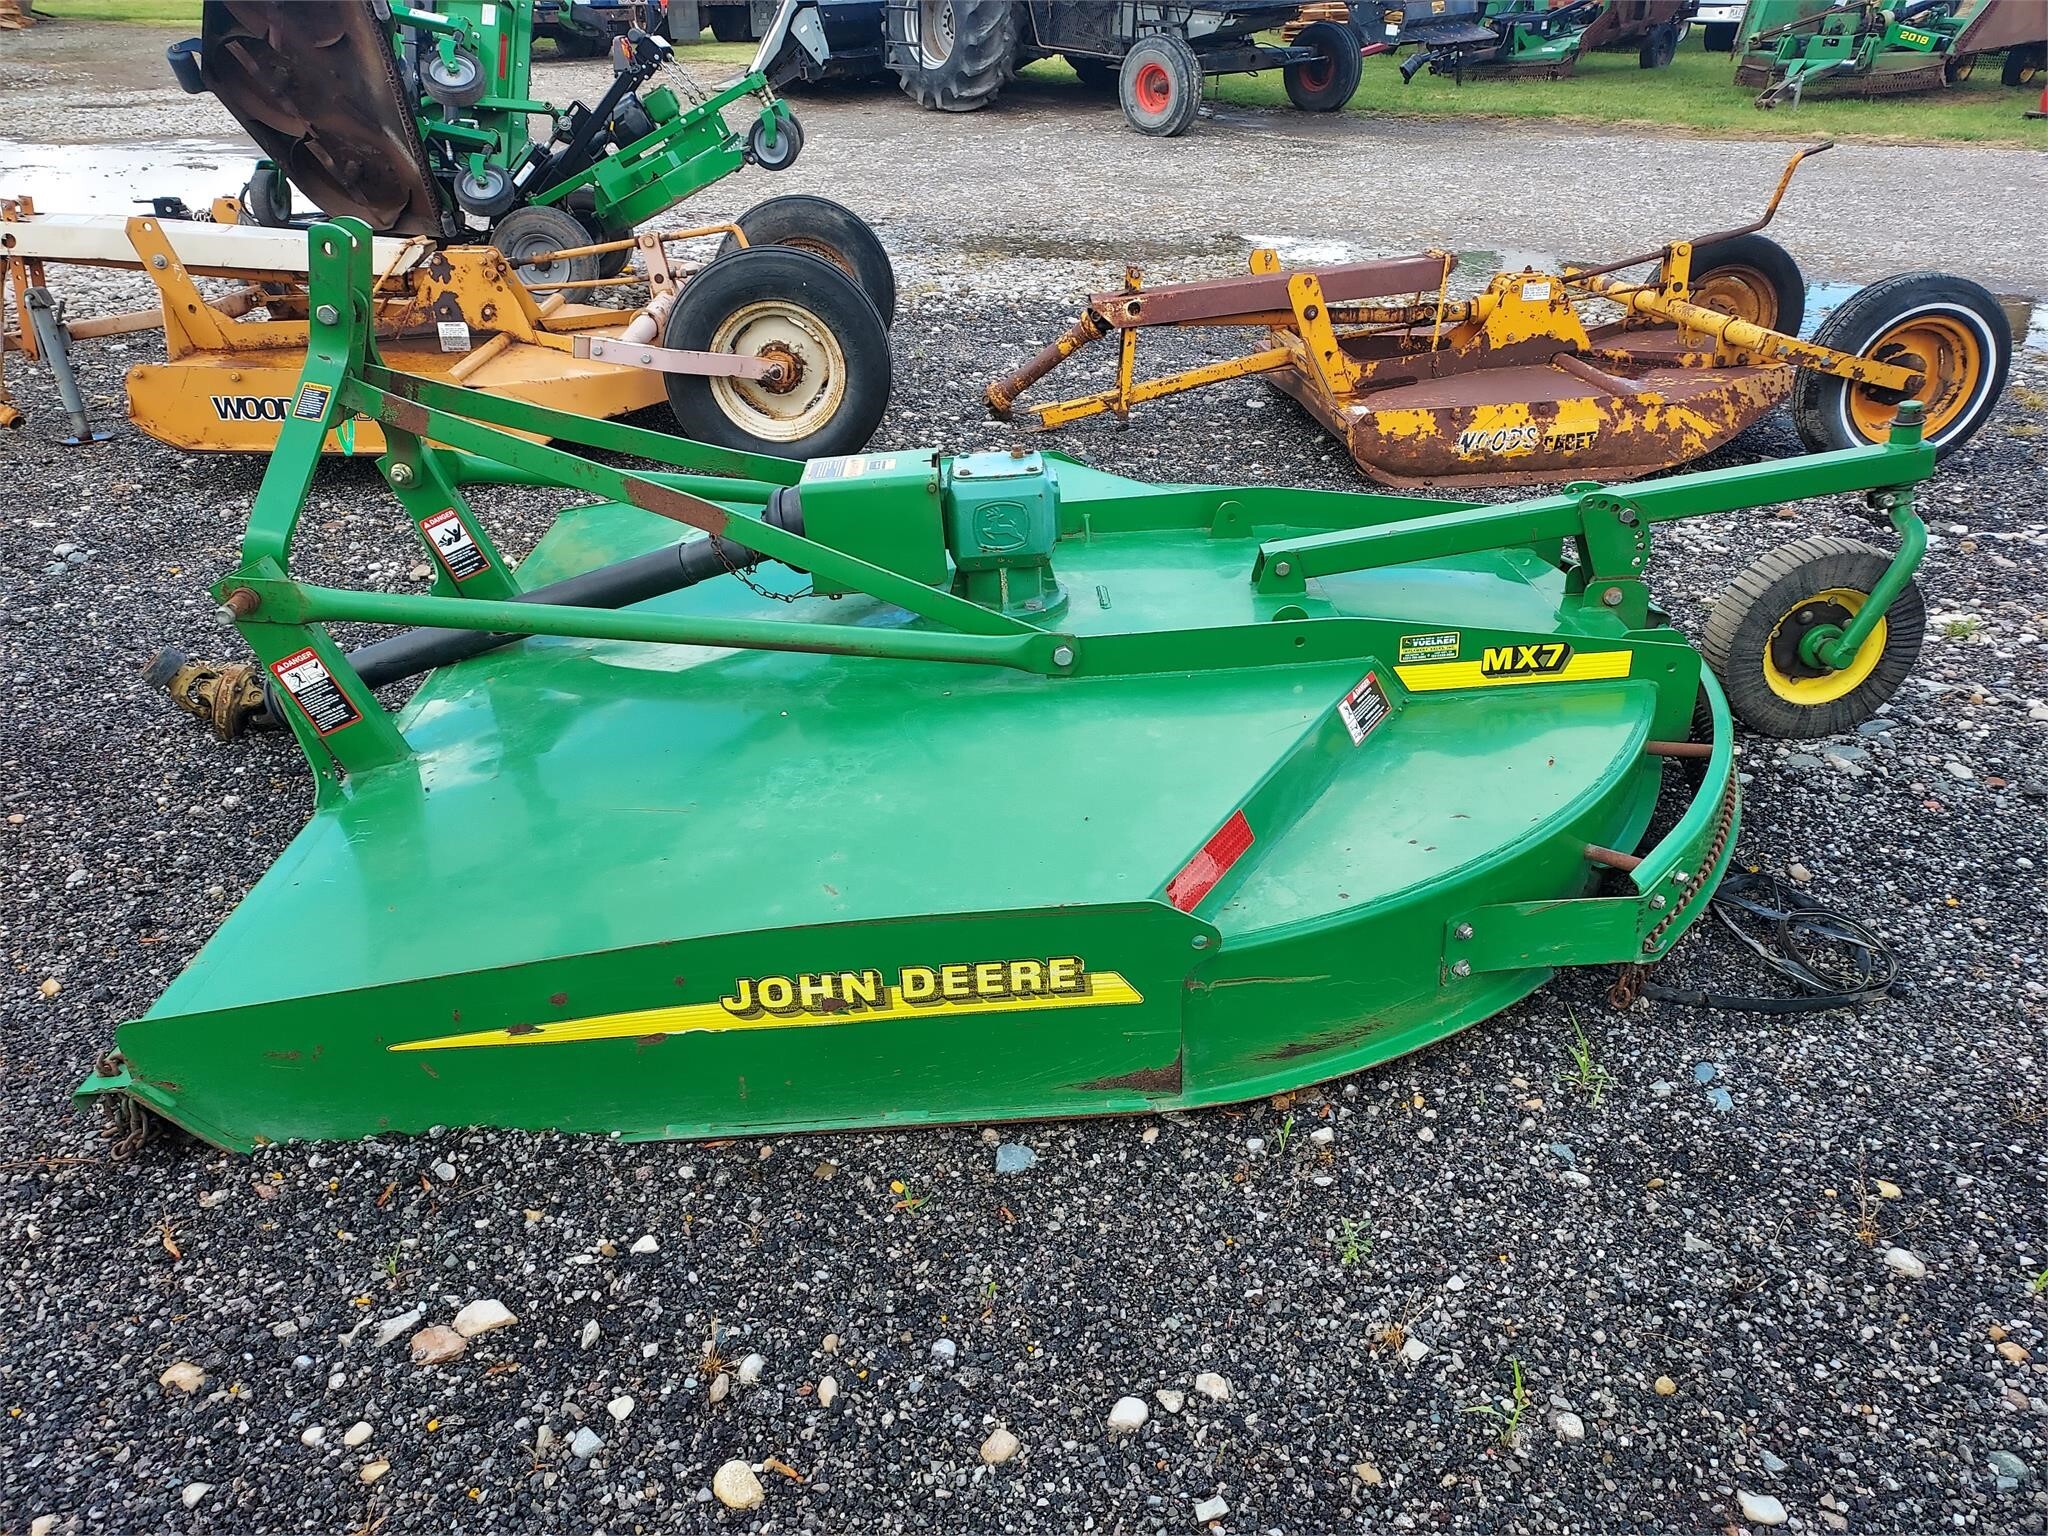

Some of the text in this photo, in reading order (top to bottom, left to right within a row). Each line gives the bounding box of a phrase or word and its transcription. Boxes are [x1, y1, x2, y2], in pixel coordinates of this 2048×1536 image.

[1900, 31, 1929, 45] 2018
[211, 396, 293, 421] WOOD
[429, 510, 455, 526] DANGER
[1412, 635, 1456, 647] VOELKER
[282, 651, 313, 668] DANGER
[1481, 642, 1571, 676] MX7
[720, 956, 1083, 1014] JOHN DEERE
